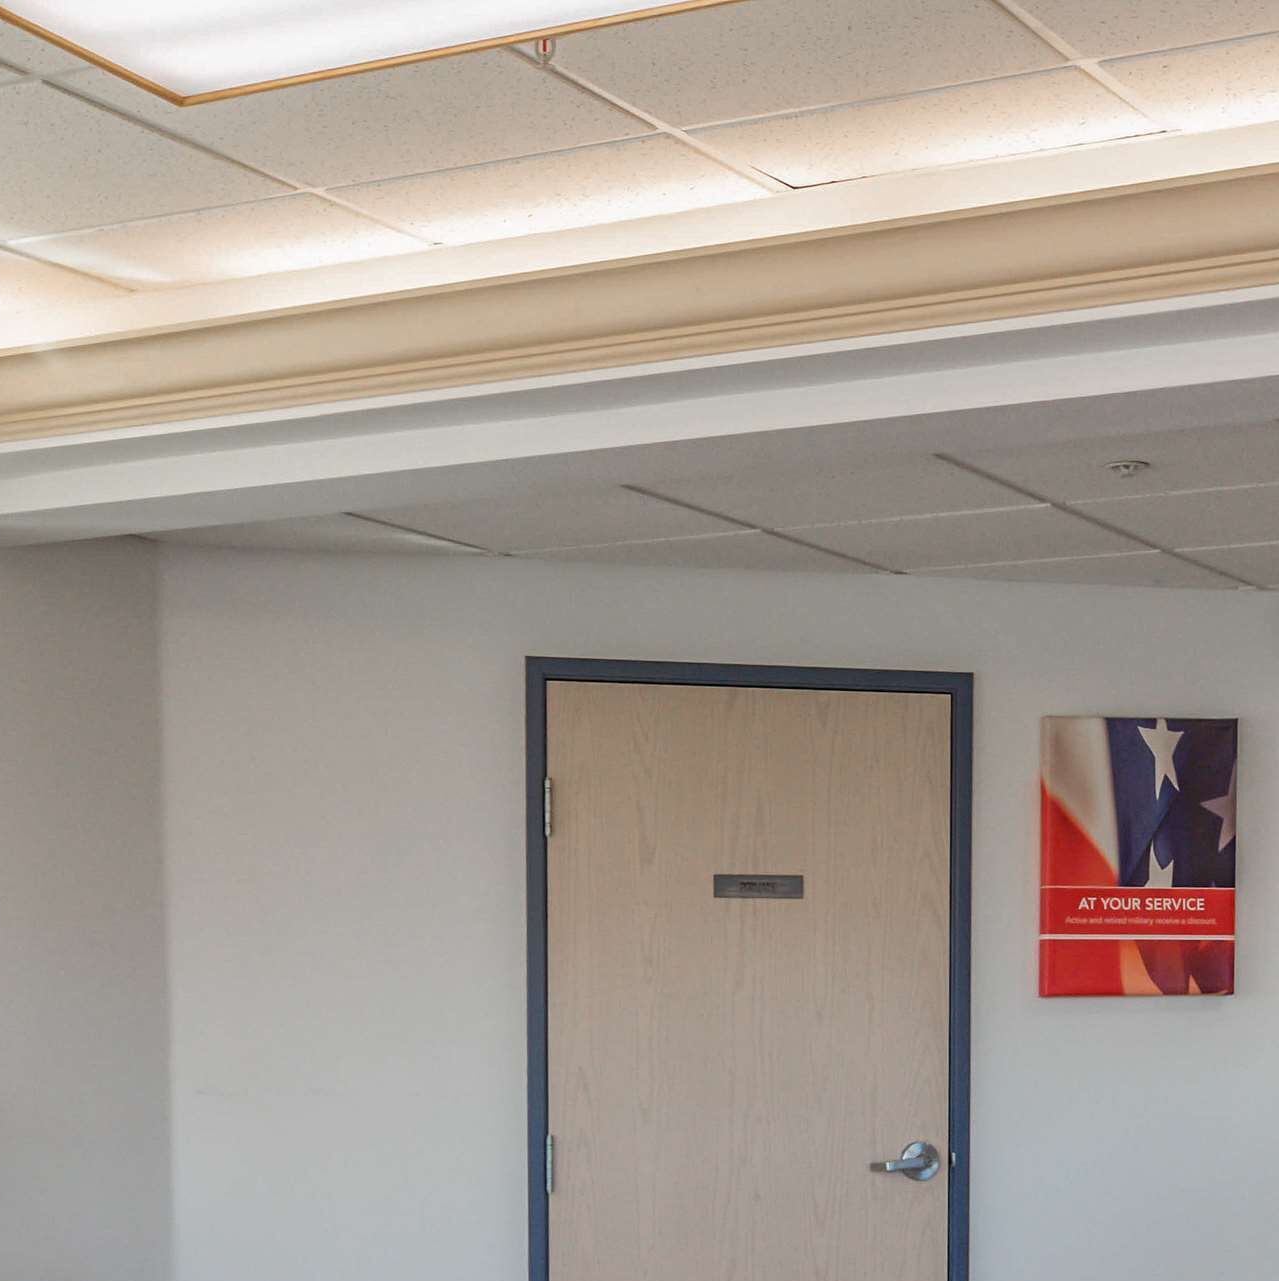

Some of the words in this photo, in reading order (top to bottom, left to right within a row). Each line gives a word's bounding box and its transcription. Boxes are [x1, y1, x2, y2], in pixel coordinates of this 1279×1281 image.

[1078, 897, 1097, 911] AT
[1100, 897, 1141, 911] YOUR
[1145, 897, 1206, 911] SERVICE
